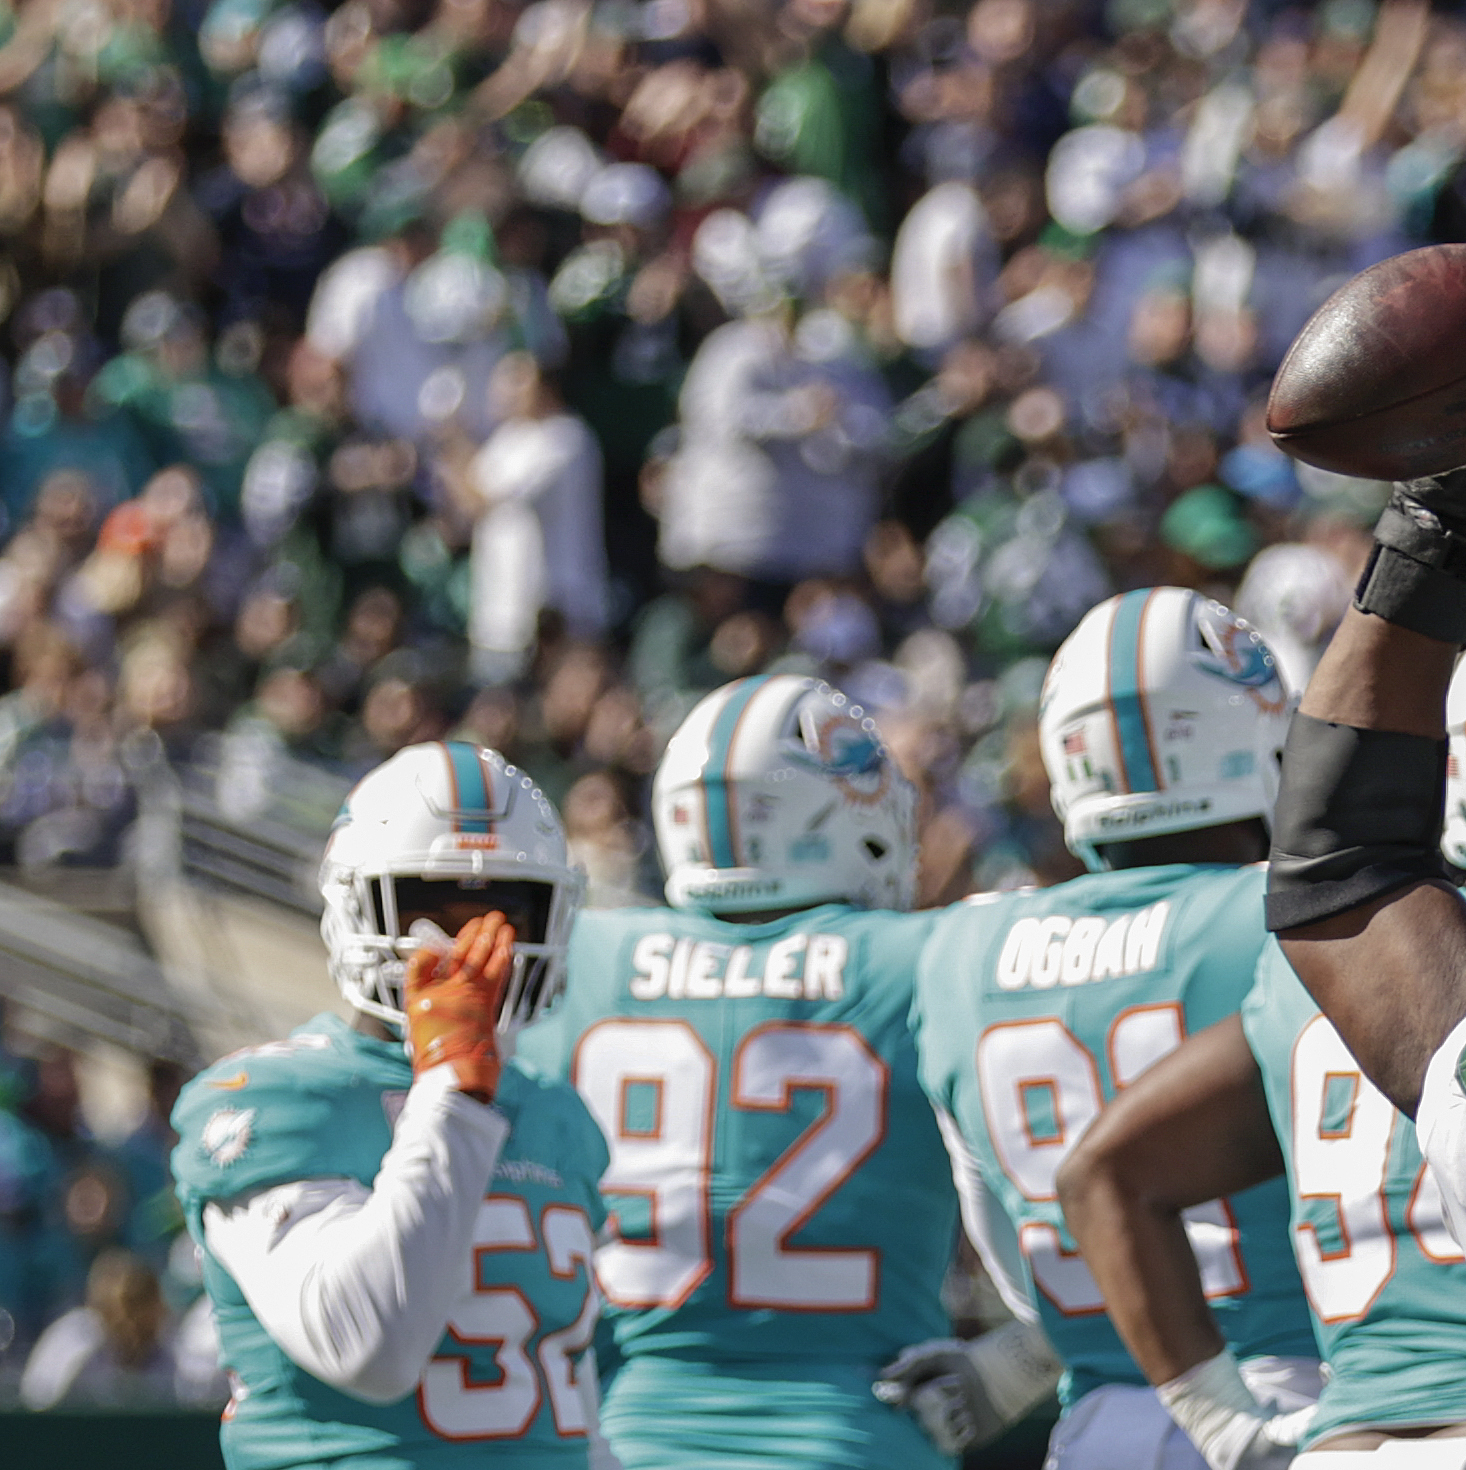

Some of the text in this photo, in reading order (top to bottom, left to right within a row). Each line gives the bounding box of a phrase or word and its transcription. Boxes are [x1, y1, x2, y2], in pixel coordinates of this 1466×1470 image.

[629, 932, 848, 1001] SIELER
[996, 900, 1172, 992] OGBAH
[571, 1017, 890, 1313] 92
[416, 1191, 591, 1441] 52
